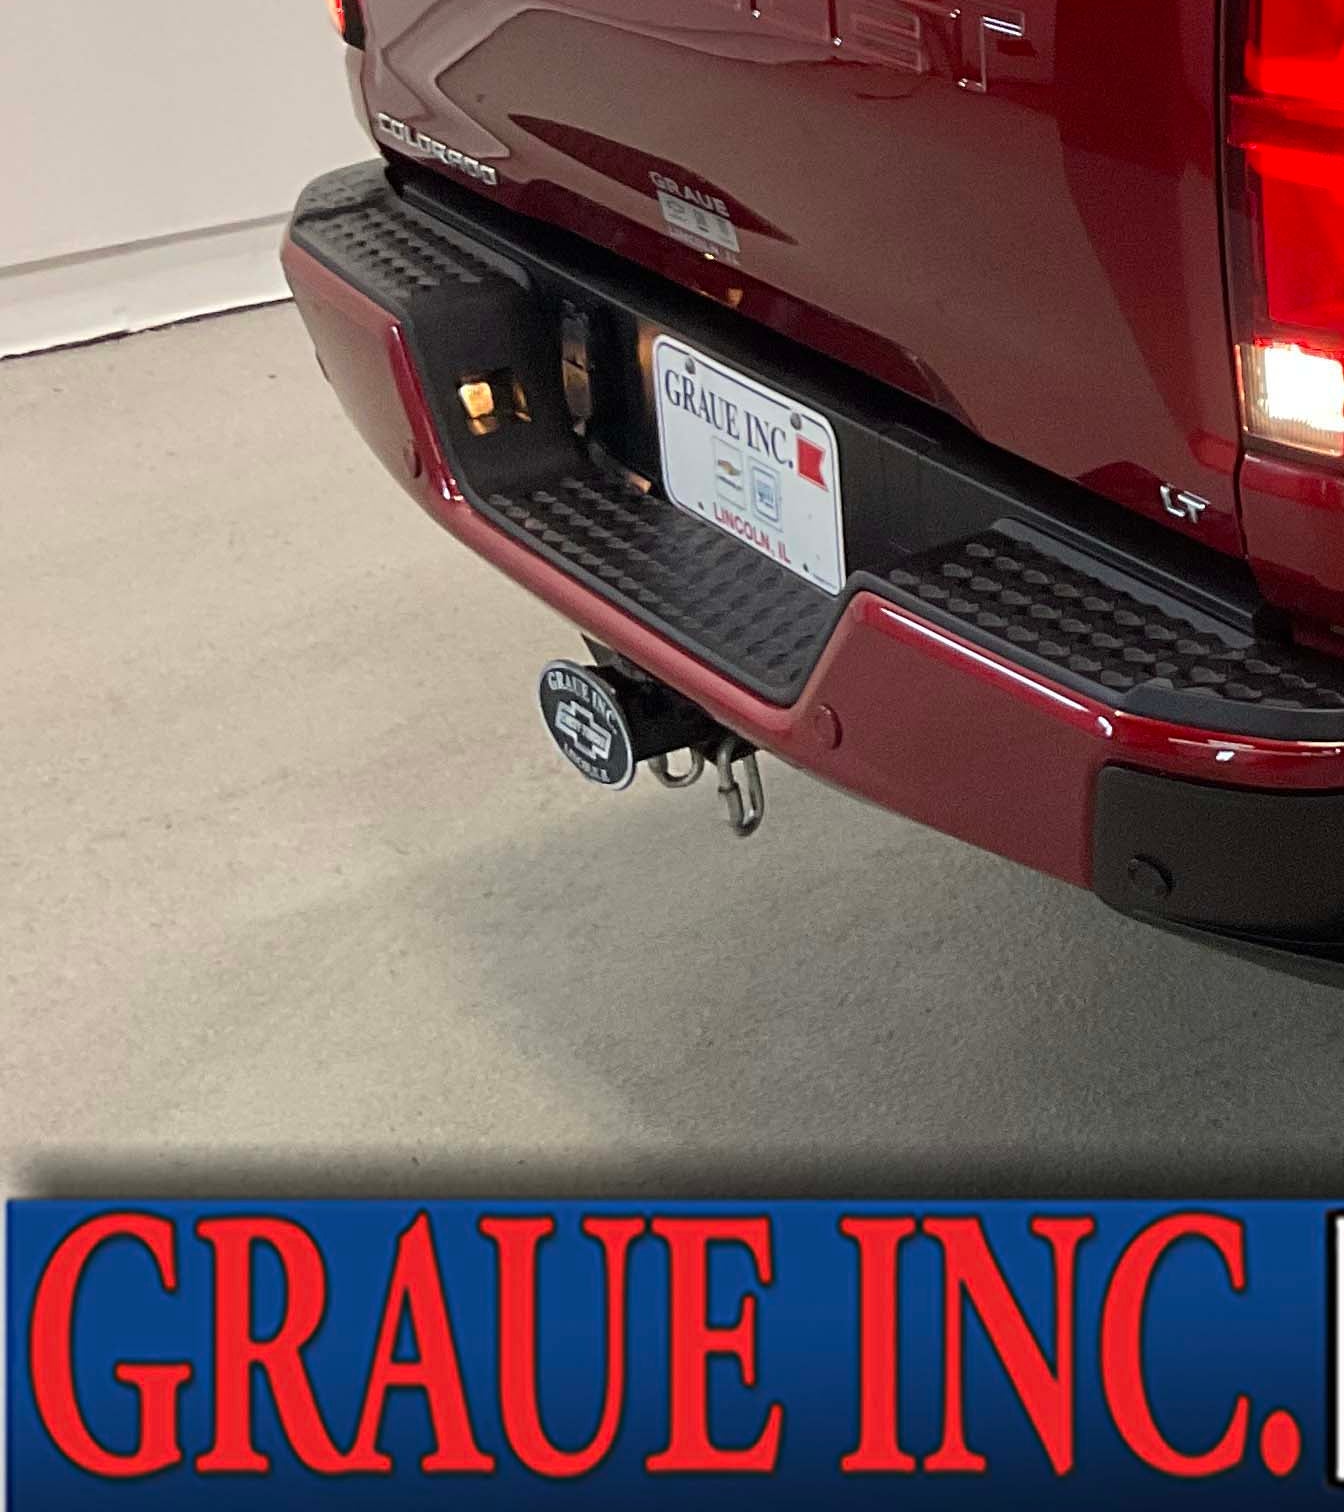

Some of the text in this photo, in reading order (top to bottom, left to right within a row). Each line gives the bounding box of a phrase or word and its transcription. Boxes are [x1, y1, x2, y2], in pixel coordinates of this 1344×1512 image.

[378, 112, 497, 186] COLORADO
[648, 171, 731, 218] GRAUE
[665, 369, 794, 469] GRAUE INC.
[1160, 485, 1206, 524] LT
[777, 541, 792, 565] IL
[548, 671, 591, 703] GRAUE
